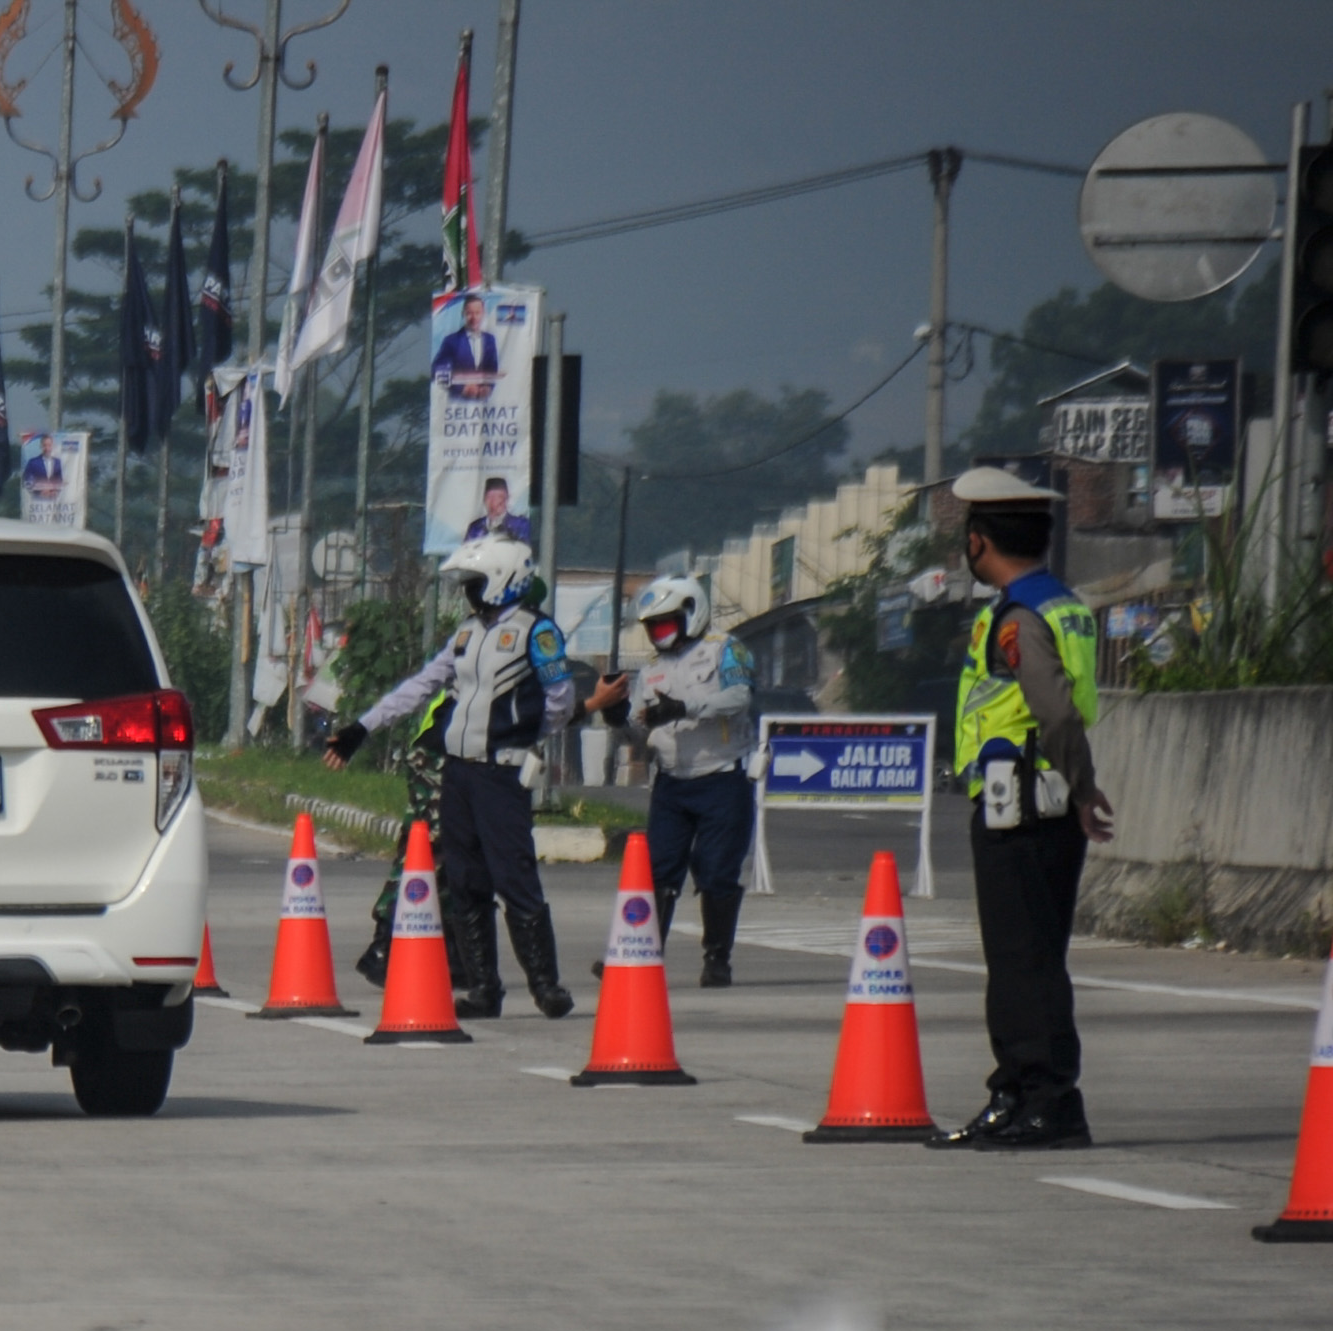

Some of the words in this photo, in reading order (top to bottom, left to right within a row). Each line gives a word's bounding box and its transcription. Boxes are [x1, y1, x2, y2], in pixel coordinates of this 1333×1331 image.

[444, 406, 518, 421] SELAMAT
[443, 423, 518, 437] DATANG
[482, 440, 518, 457] AHY
[29, 502, 76, 513] SELAMAT
[837, 745, 912, 767] JALUR
[830, 769, 874, 789] BALIK
[876, 769, 918, 789] ARAH
